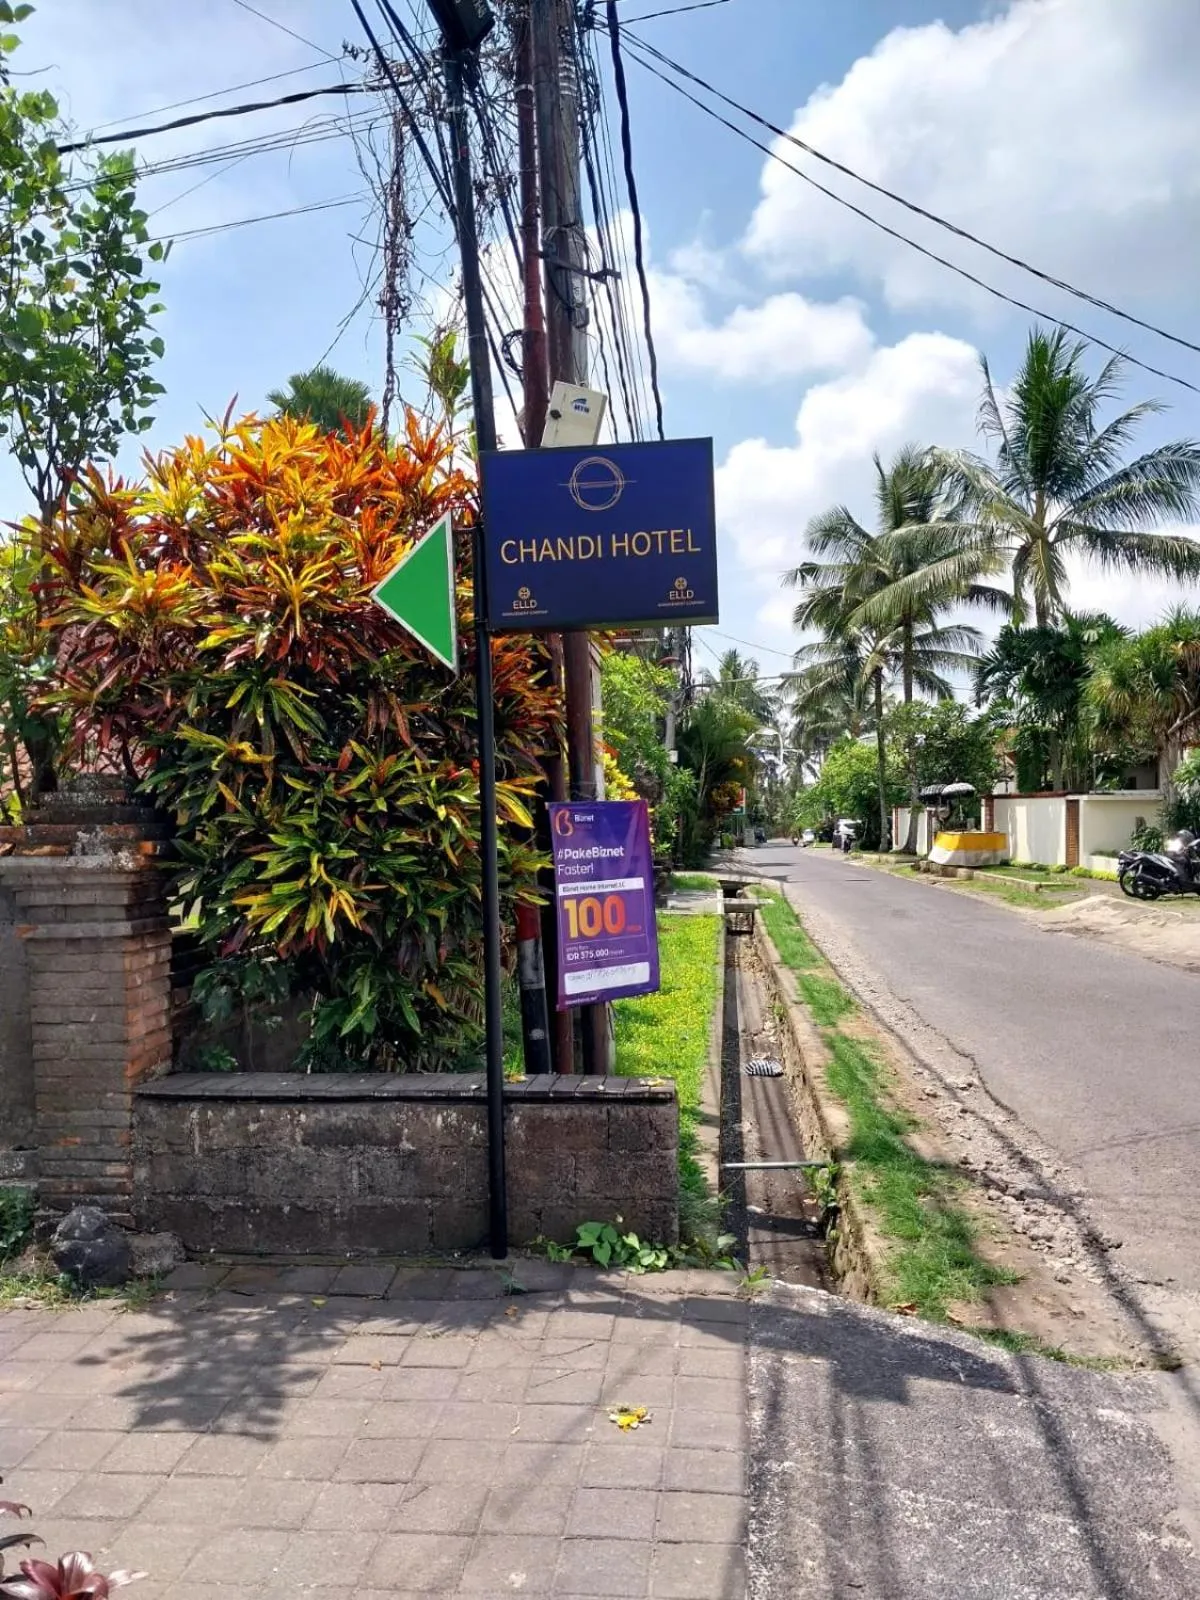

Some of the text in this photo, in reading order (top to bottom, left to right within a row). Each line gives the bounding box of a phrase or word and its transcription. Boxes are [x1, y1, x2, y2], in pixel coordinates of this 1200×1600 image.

[500, 528, 702, 564] CHANDI HOTEL
[669, 590, 694, 601] ELLD
[513, 599, 538, 610] ELLD
[574, 814, 594, 822] Biznet
[557, 846, 624, 859] #PakeBiznet
[558, 862, 594, 876] Faster!
[564, 895, 625, 938] 100
[566, 952, 579, 961] IDR
